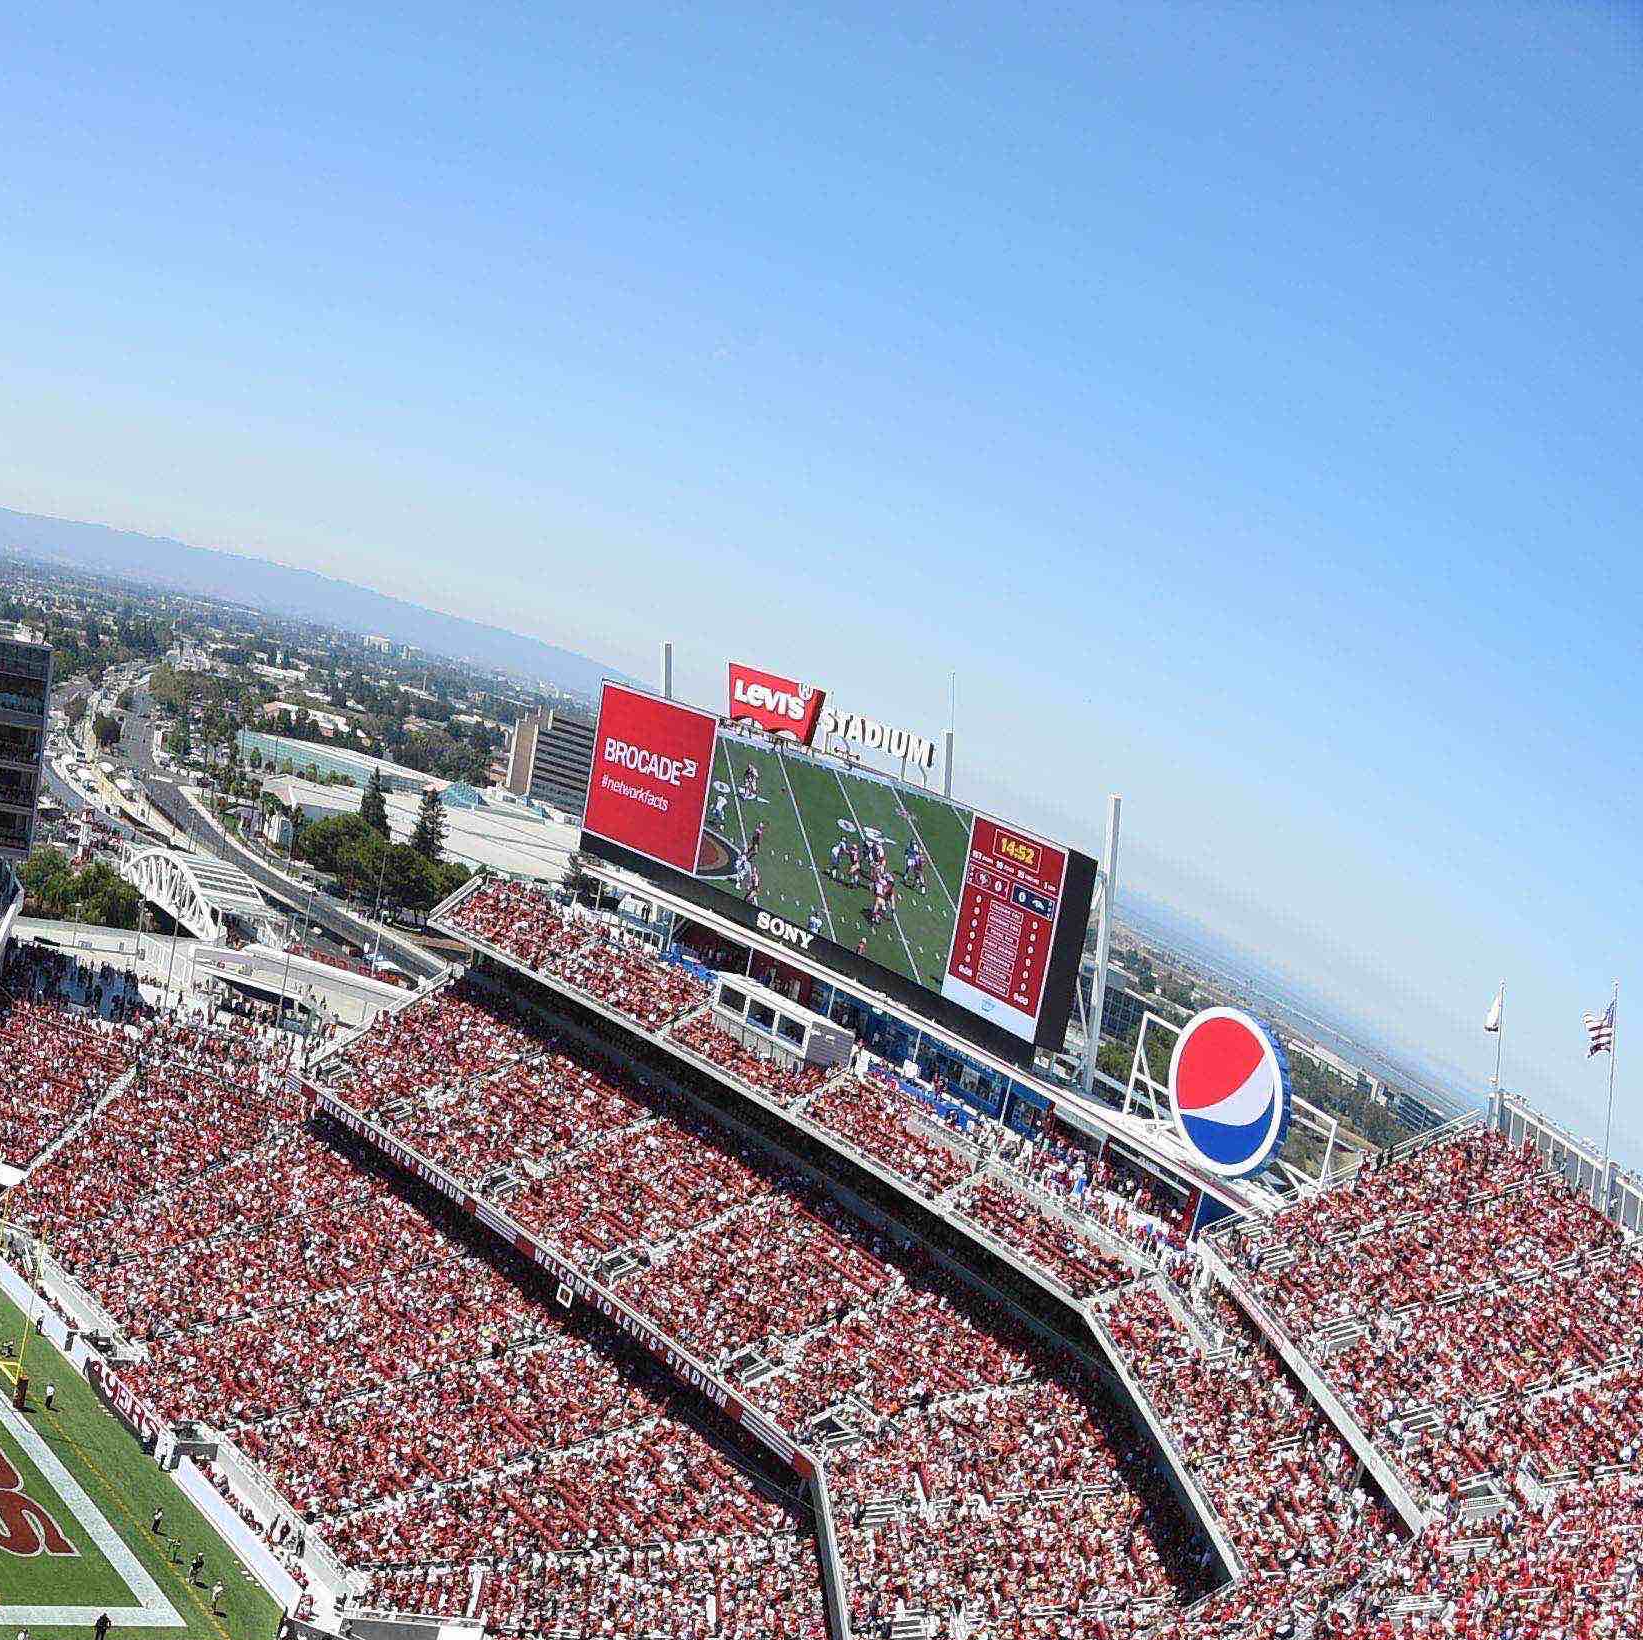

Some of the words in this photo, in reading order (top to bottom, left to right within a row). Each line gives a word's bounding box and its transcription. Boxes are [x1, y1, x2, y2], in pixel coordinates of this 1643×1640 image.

[603, 737, 683, 787] BROCADE
[820, 708, 935, 769] STADIUM
[601, 772, 669, 812] #networkfacts
[756, 911, 814, 949] SONY
[315, 1093, 362, 1133] WELCOME
[364, 1128, 376, 1142] TO
[417, 1163, 465, 1206] STADIUM
[534, 1249, 593, 1301] WELCOME
[597, 1295, 612, 1315] TO
[666, 1350, 729, 1408] STADIUM
